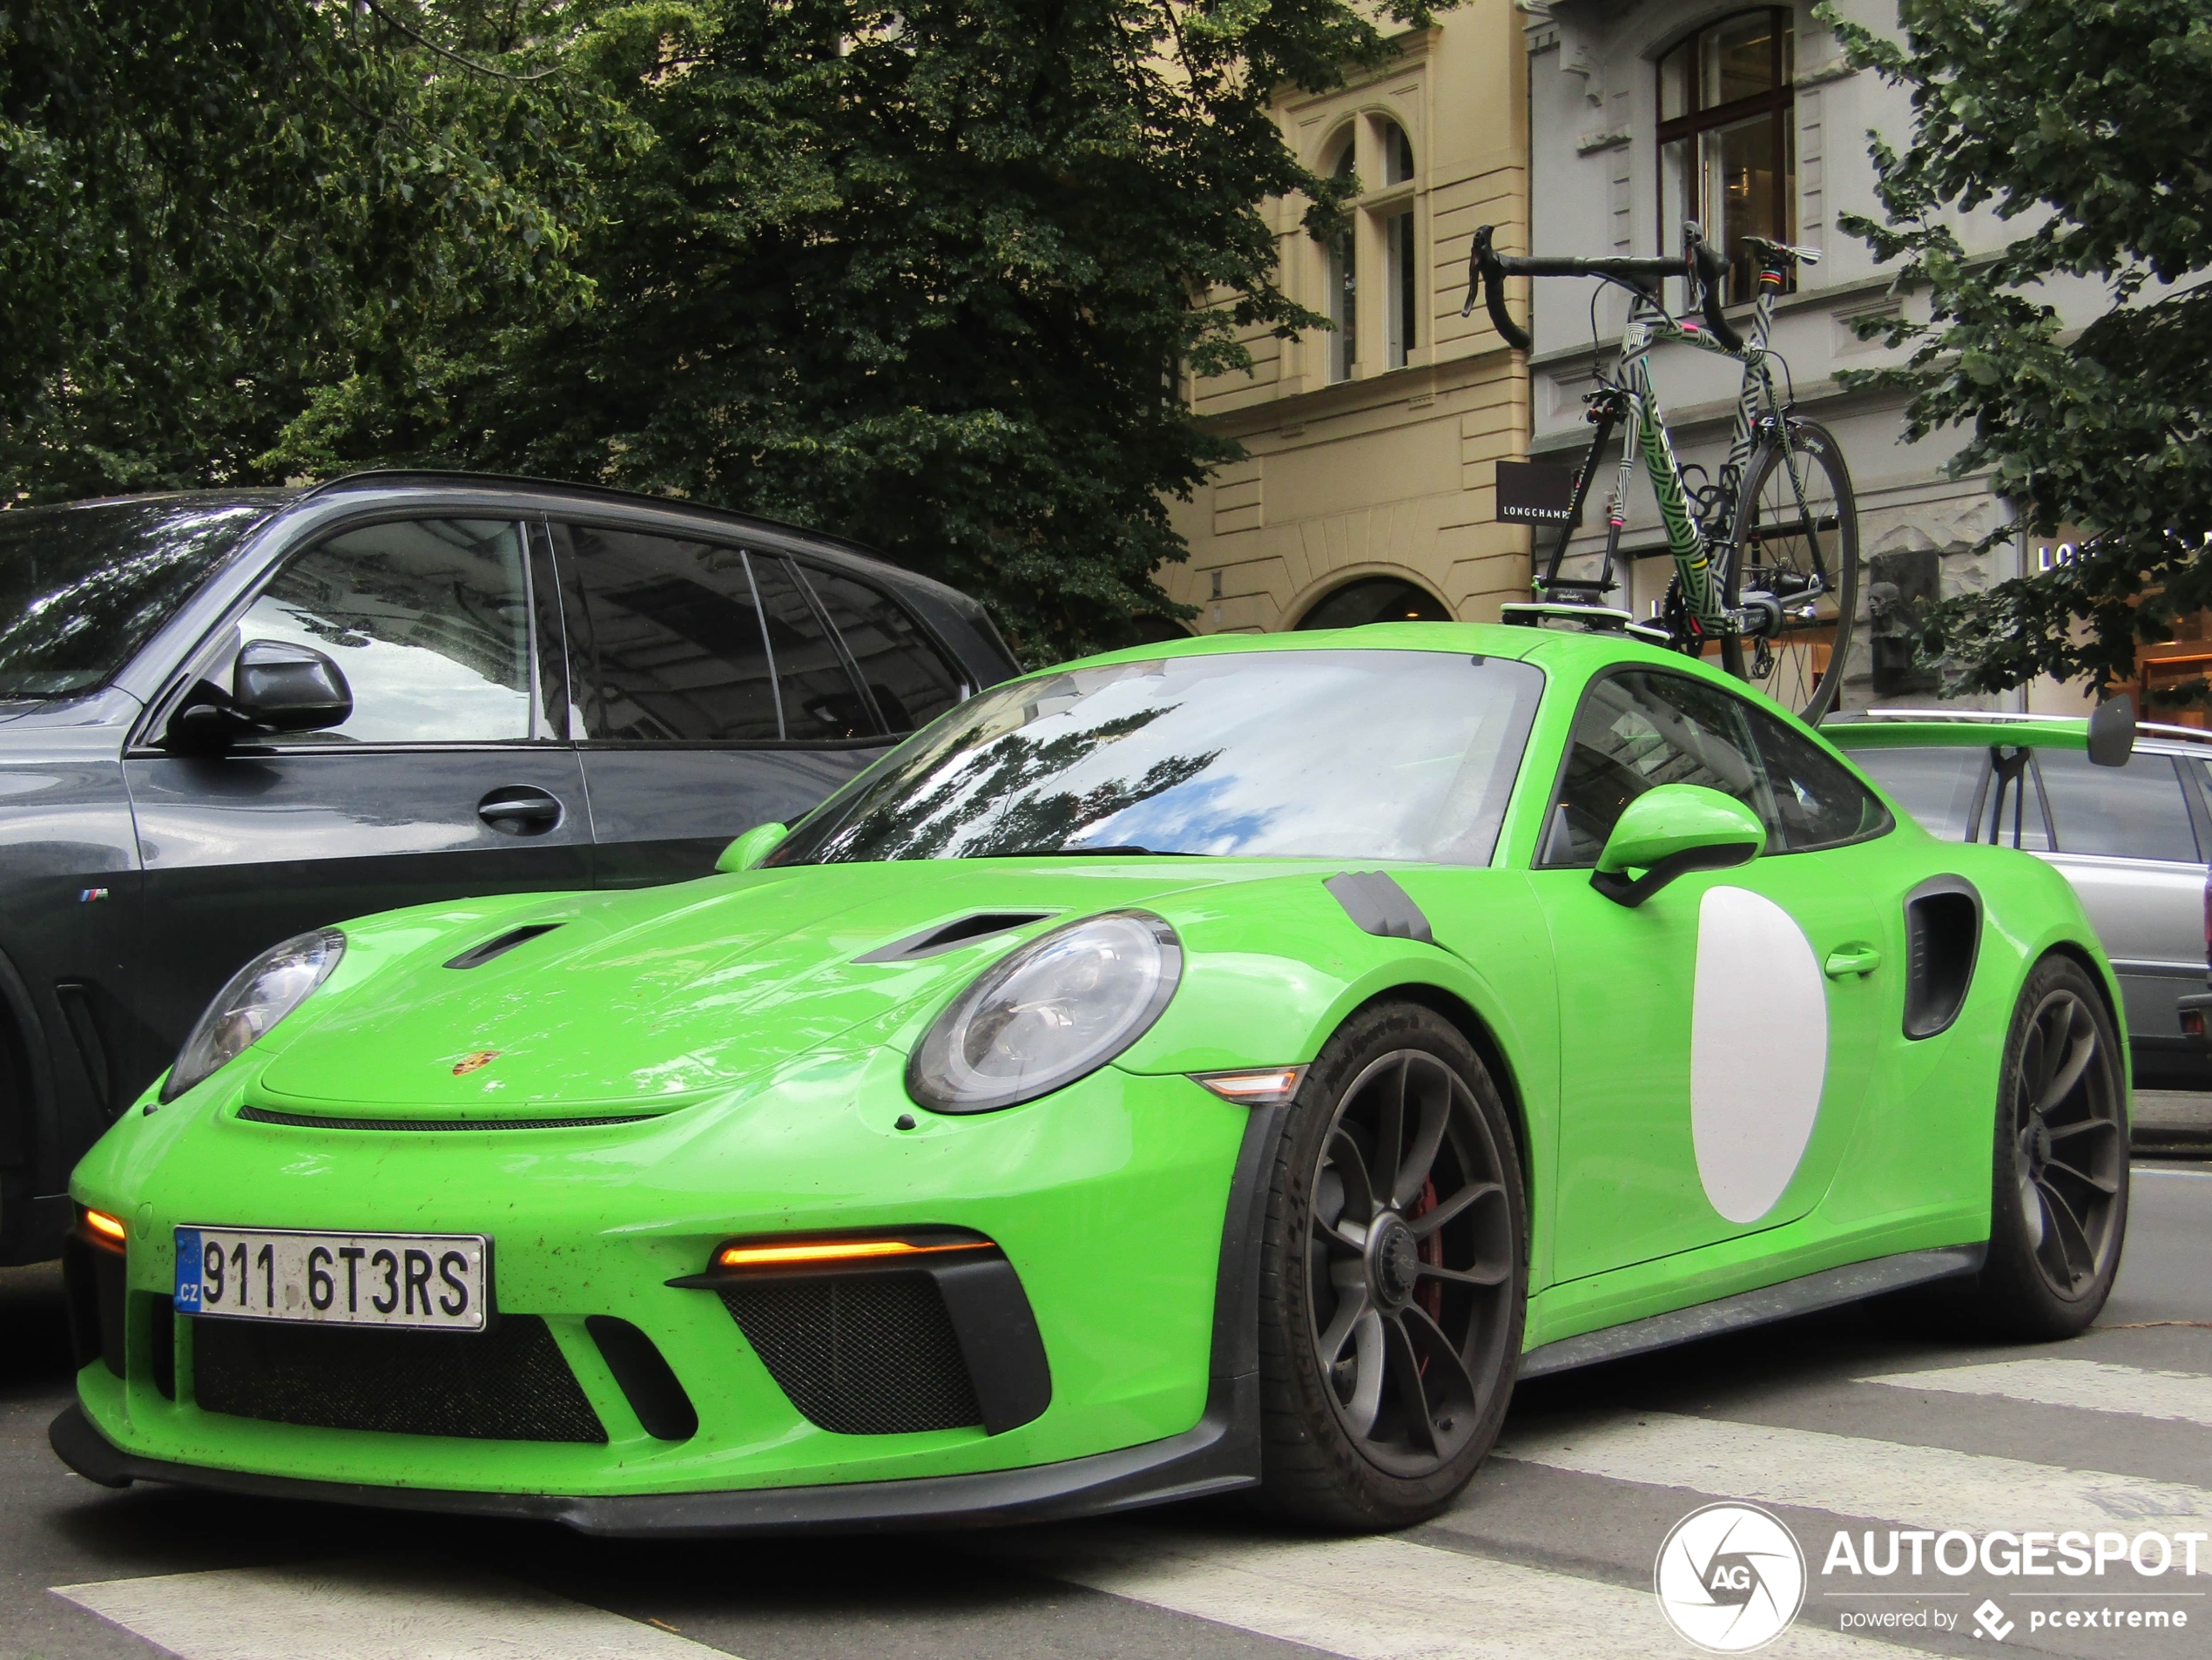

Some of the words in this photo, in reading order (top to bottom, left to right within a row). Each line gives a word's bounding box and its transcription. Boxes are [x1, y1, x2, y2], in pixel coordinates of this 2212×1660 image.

[1503, 506, 1568, 519] LONGCHAMP
[203, 1240, 275, 1307] 911
[308, 1245, 469, 1316] 6T3RS
[180, 1283, 199, 1303] CZ
